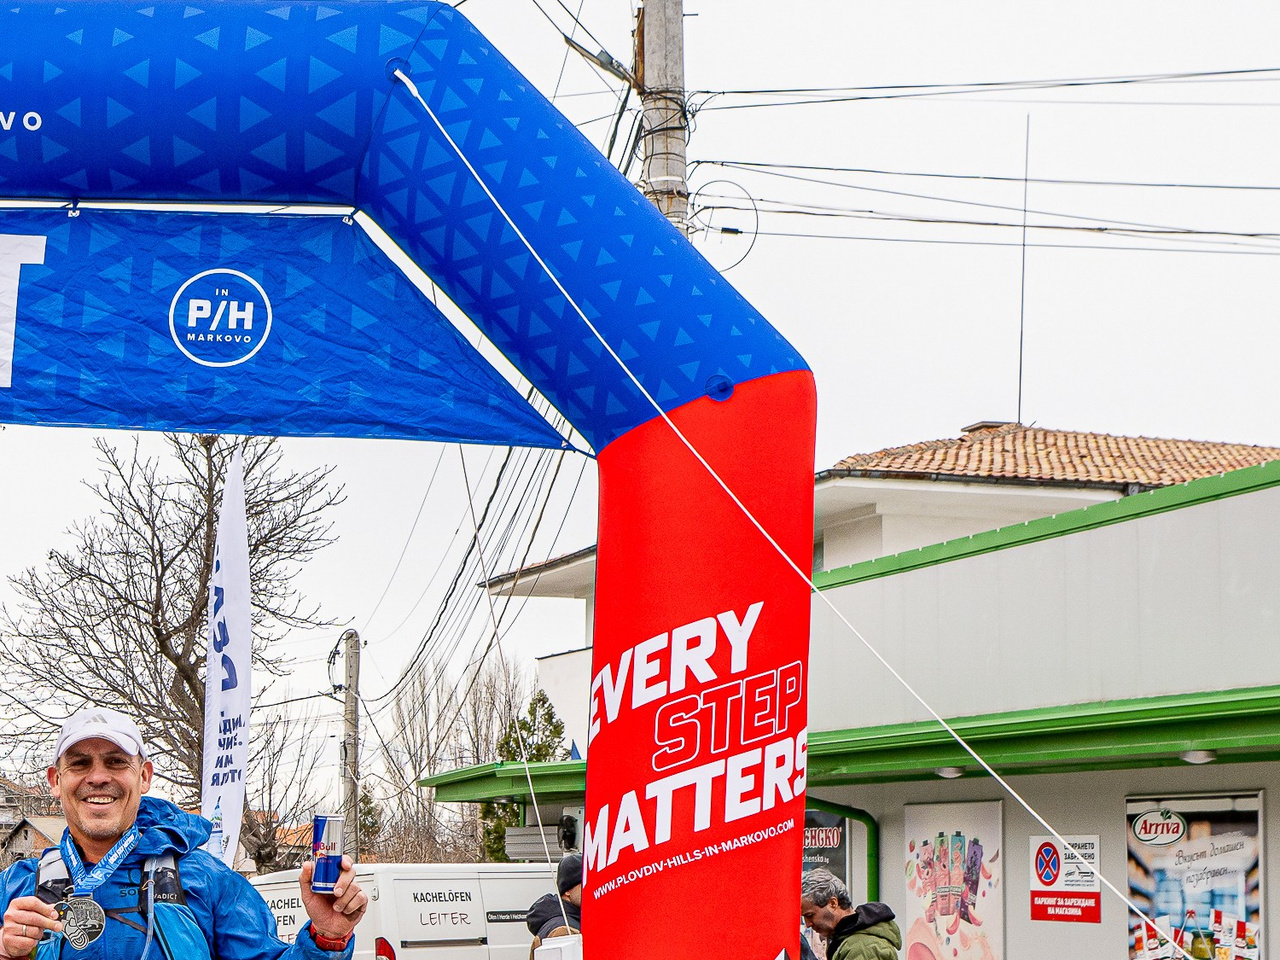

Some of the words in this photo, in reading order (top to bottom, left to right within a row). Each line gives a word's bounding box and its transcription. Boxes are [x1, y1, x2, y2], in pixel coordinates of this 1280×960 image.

[215, 288, 229, 297] IN
[187, 299, 254, 331] P/H
[187, 333, 252, 343] MARKOVO
[588, 600, 765, 748] EVERY
[652, 660, 802, 772] STEP
[582, 725, 808, 888] MATTERS
[1138, 818, 1181, 836] Arriva
[803, 827, 841, 849] ЕНСКО
[1064, 842, 1095, 850] СИРАНЕТО
[593, 818, 795, 900] WWW.PLOVDIV-HILLS-IN-MARKOVO.COM
[802, 854, 830, 864] shensko.bg
[412, 889, 472, 902] KACHELÖFEN
[268, 897, 302, 910] ACHEL
[275, 914, 296, 926] FEN
[419, 911, 471, 925] LEITER
